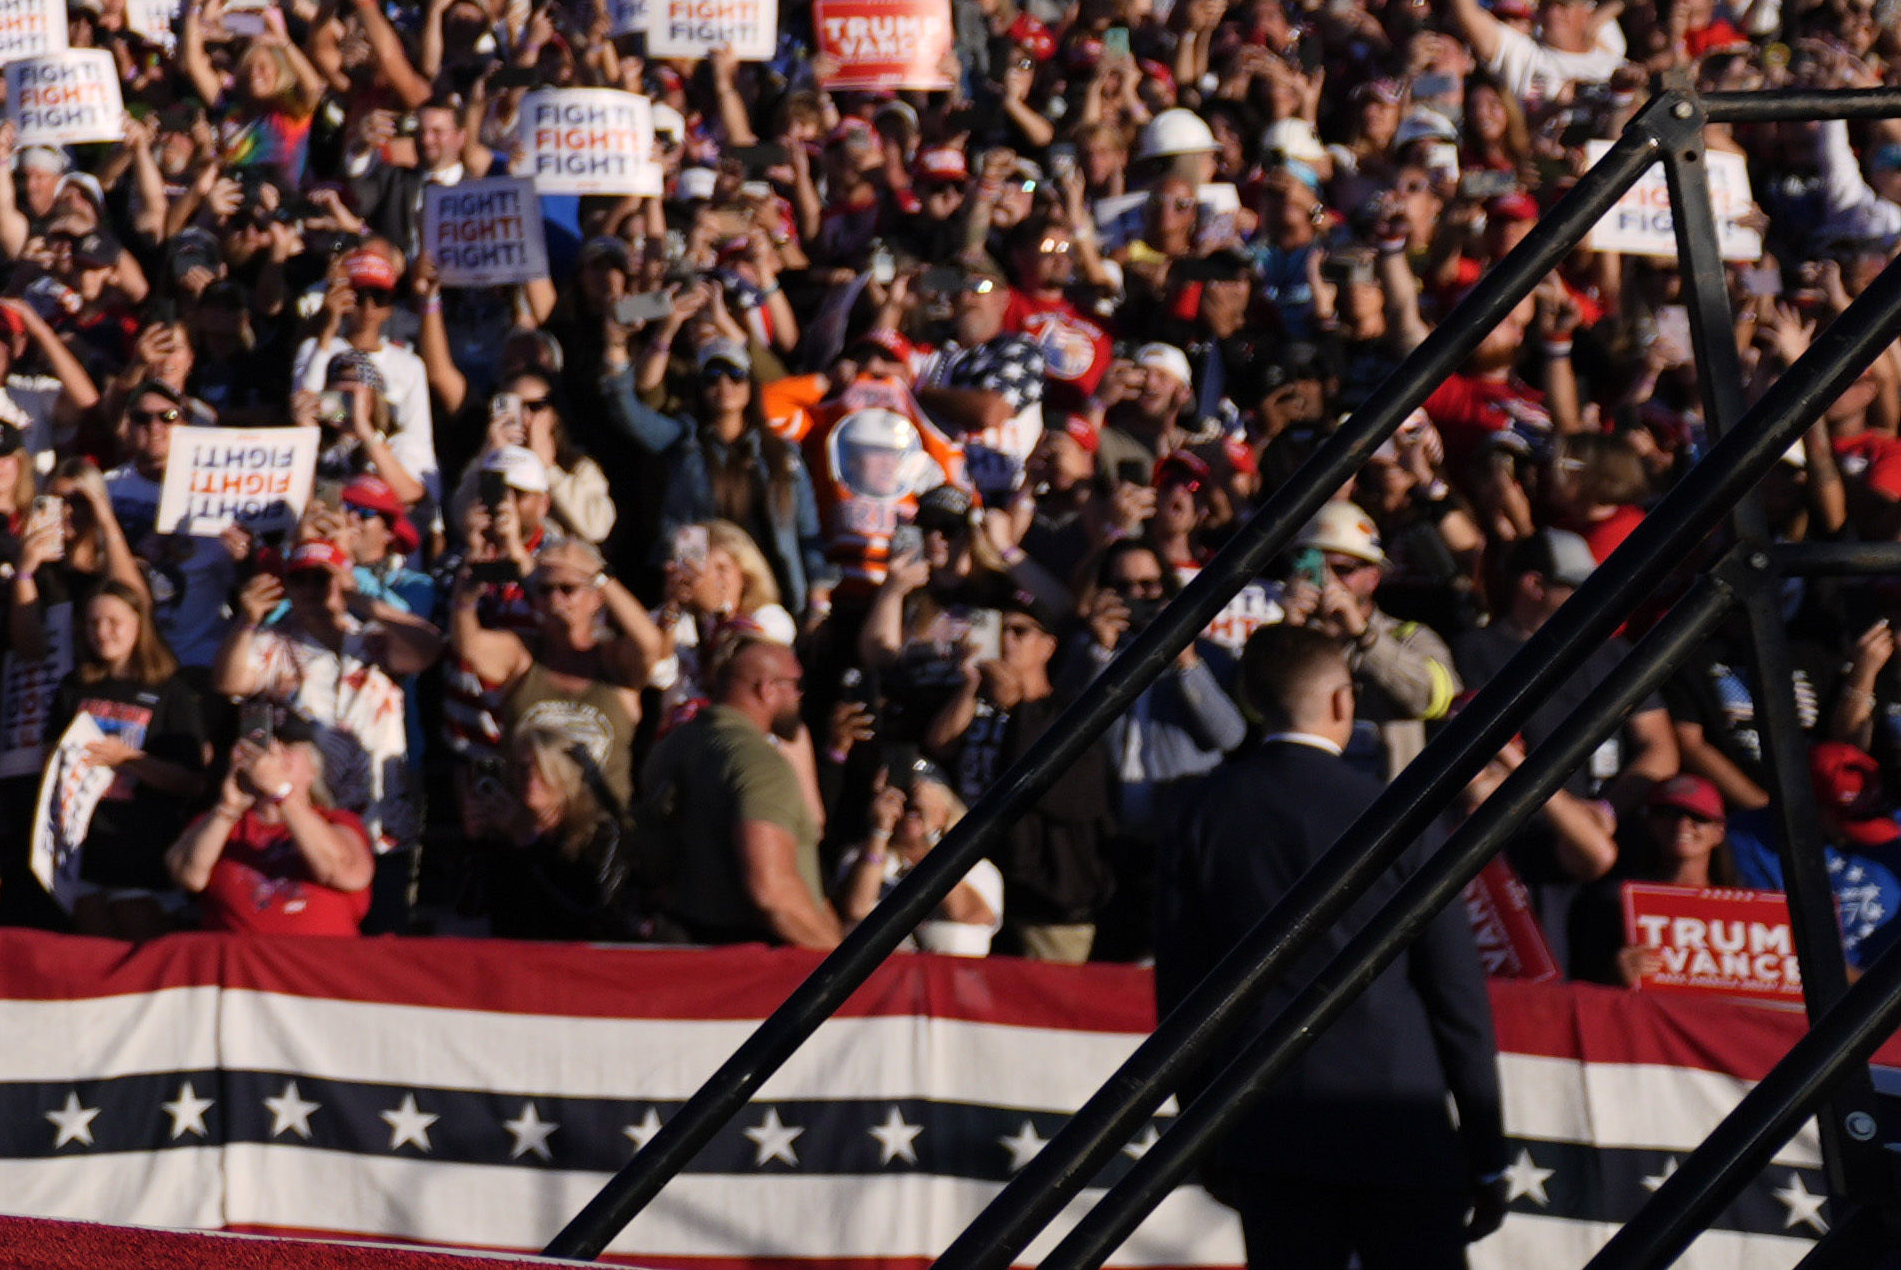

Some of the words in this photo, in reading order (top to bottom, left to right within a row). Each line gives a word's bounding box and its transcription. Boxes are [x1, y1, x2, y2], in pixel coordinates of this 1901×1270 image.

[668, 0, 760, 20] FIGHT!
[18, 62, 103, 87] FIGHT!
[19, 83, 107, 110] FIGHT!
[535, 103, 637, 126] FIGHT!
[535, 126, 638, 151] FIGHT!
[536, 151, 637, 176] FIGHT
[438, 190, 522, 222] FIGHT!
[438, 216, 524, 244] FIGHT!
[439, 241, 527, 269] FIGHT!
[192, 446, 296, 469] FIGHT!
[189, 470, 294, 495] FIGHT!
[1637, 914, 1792, 957] TRUM
[1660, 946, 1803, 985] VANCE
